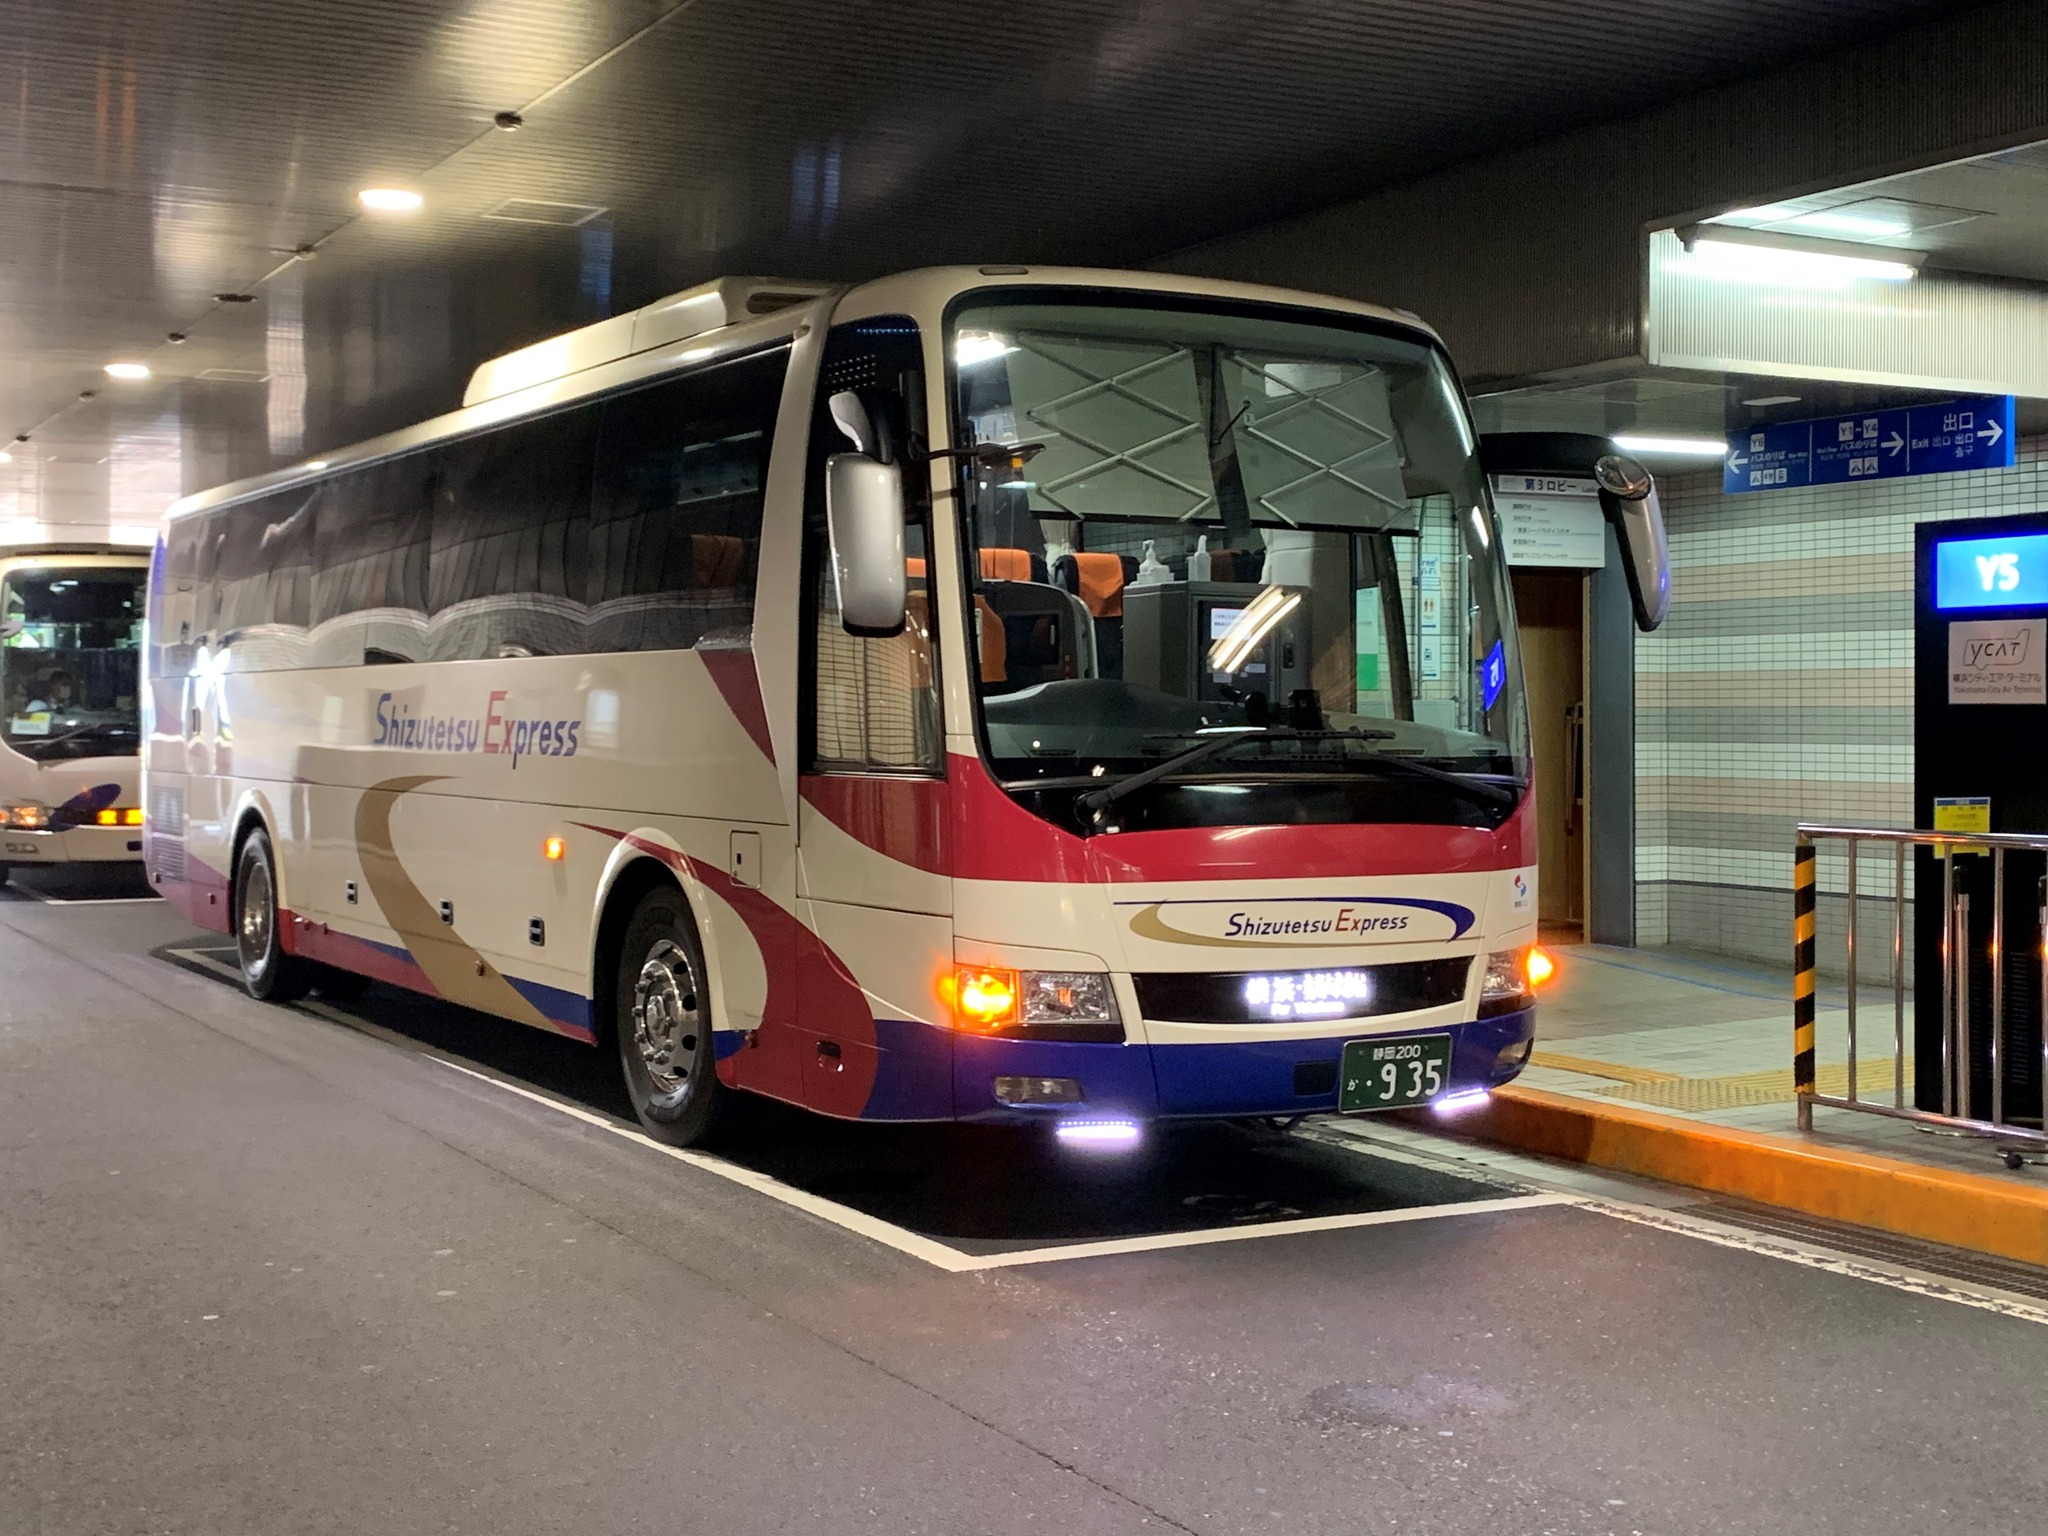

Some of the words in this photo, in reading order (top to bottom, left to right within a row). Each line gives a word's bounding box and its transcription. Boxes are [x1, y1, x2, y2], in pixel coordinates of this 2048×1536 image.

[1943, 412, 1974, 432] 出口
[1911, 438, 1929, 449] Exit
[1750, 450, 1787, 463] バスのりば
[1524, 477, 1578, 492] 第3ロビー
[1975, 553, 2020, 592] Y5
[1987, 685, 2001, 694] City
[2002, 685, 2013, 693] Air
[373, 692, 480, 753] Shizutetsu
[483, 690, 582, 770] Express
[1224, 911, 1333, 938] Shizutetsu
[1334, 908, 1410, 938] Express
